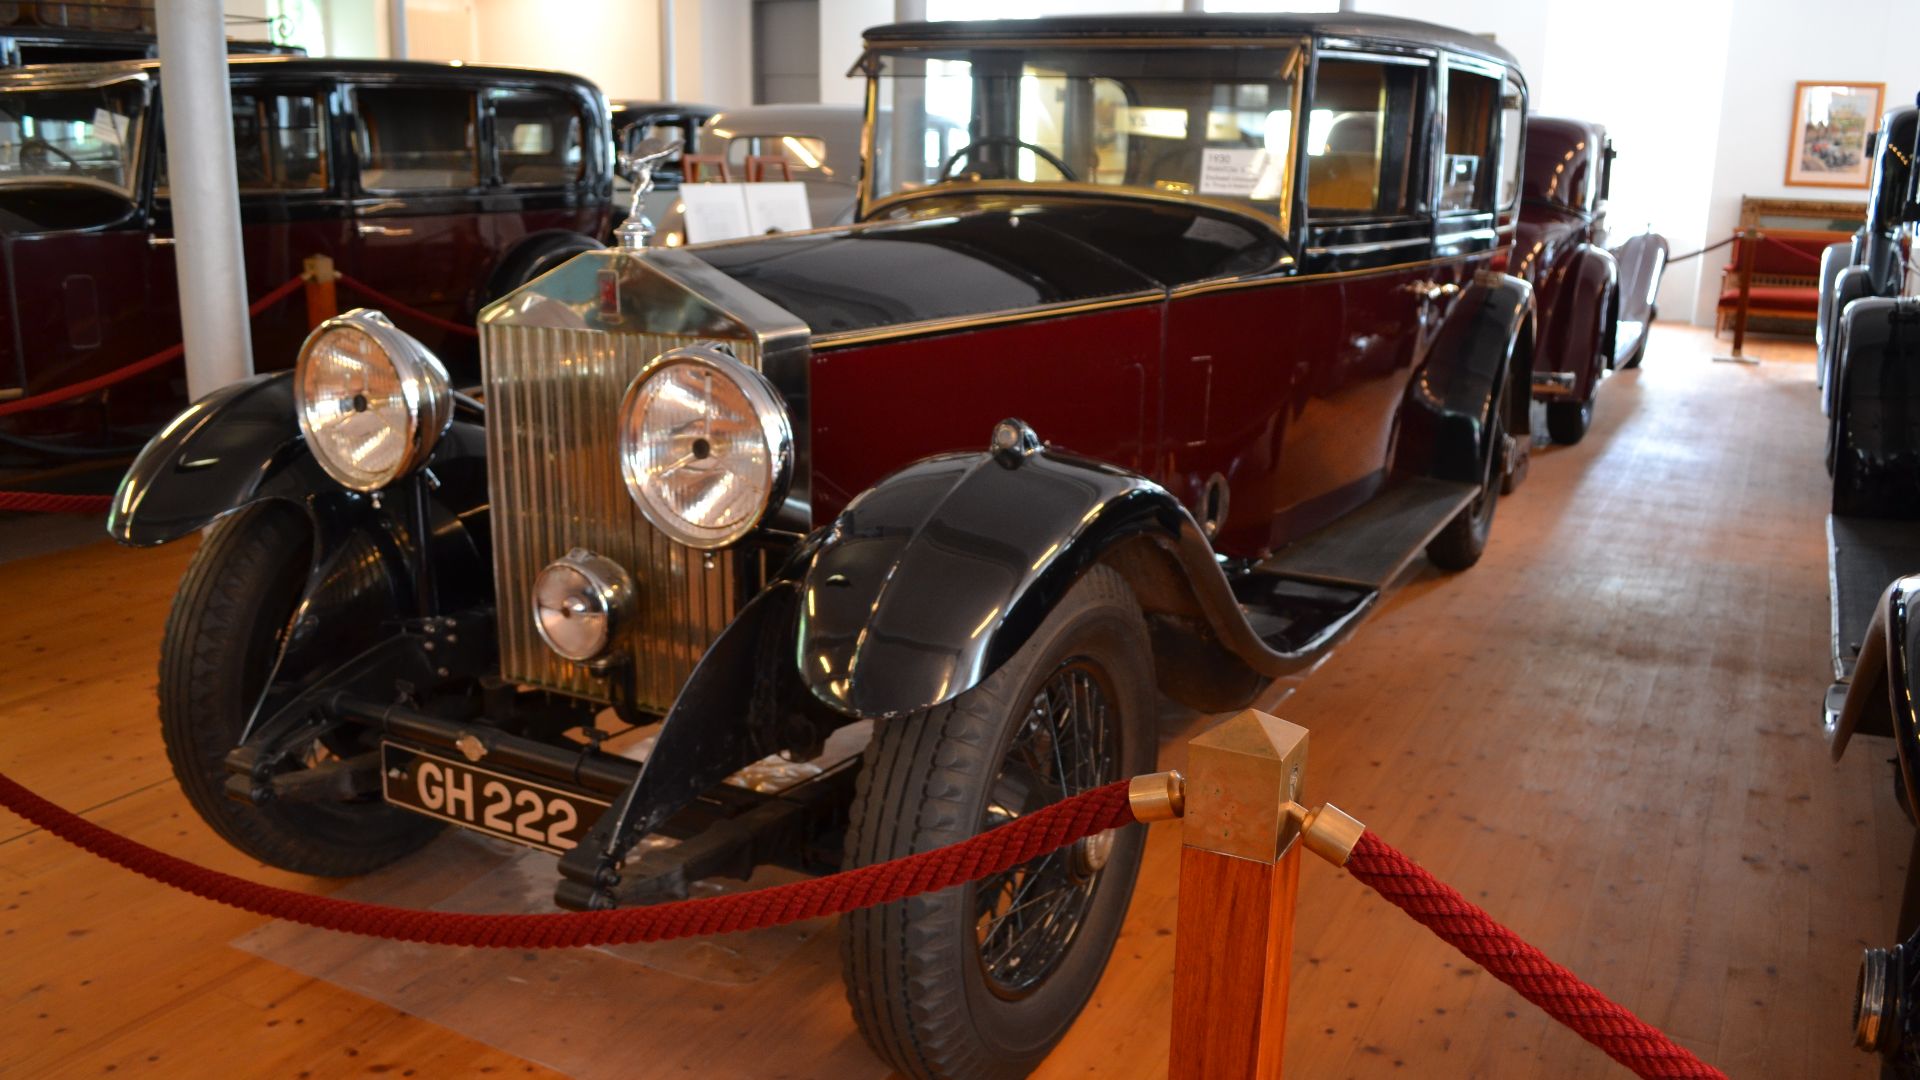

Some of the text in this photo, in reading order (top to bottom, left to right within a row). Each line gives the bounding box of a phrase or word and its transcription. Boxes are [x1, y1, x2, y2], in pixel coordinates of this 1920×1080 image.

[1208, 152, 1232, 163] 1930
[417, 762, 578, 849] GH 222
